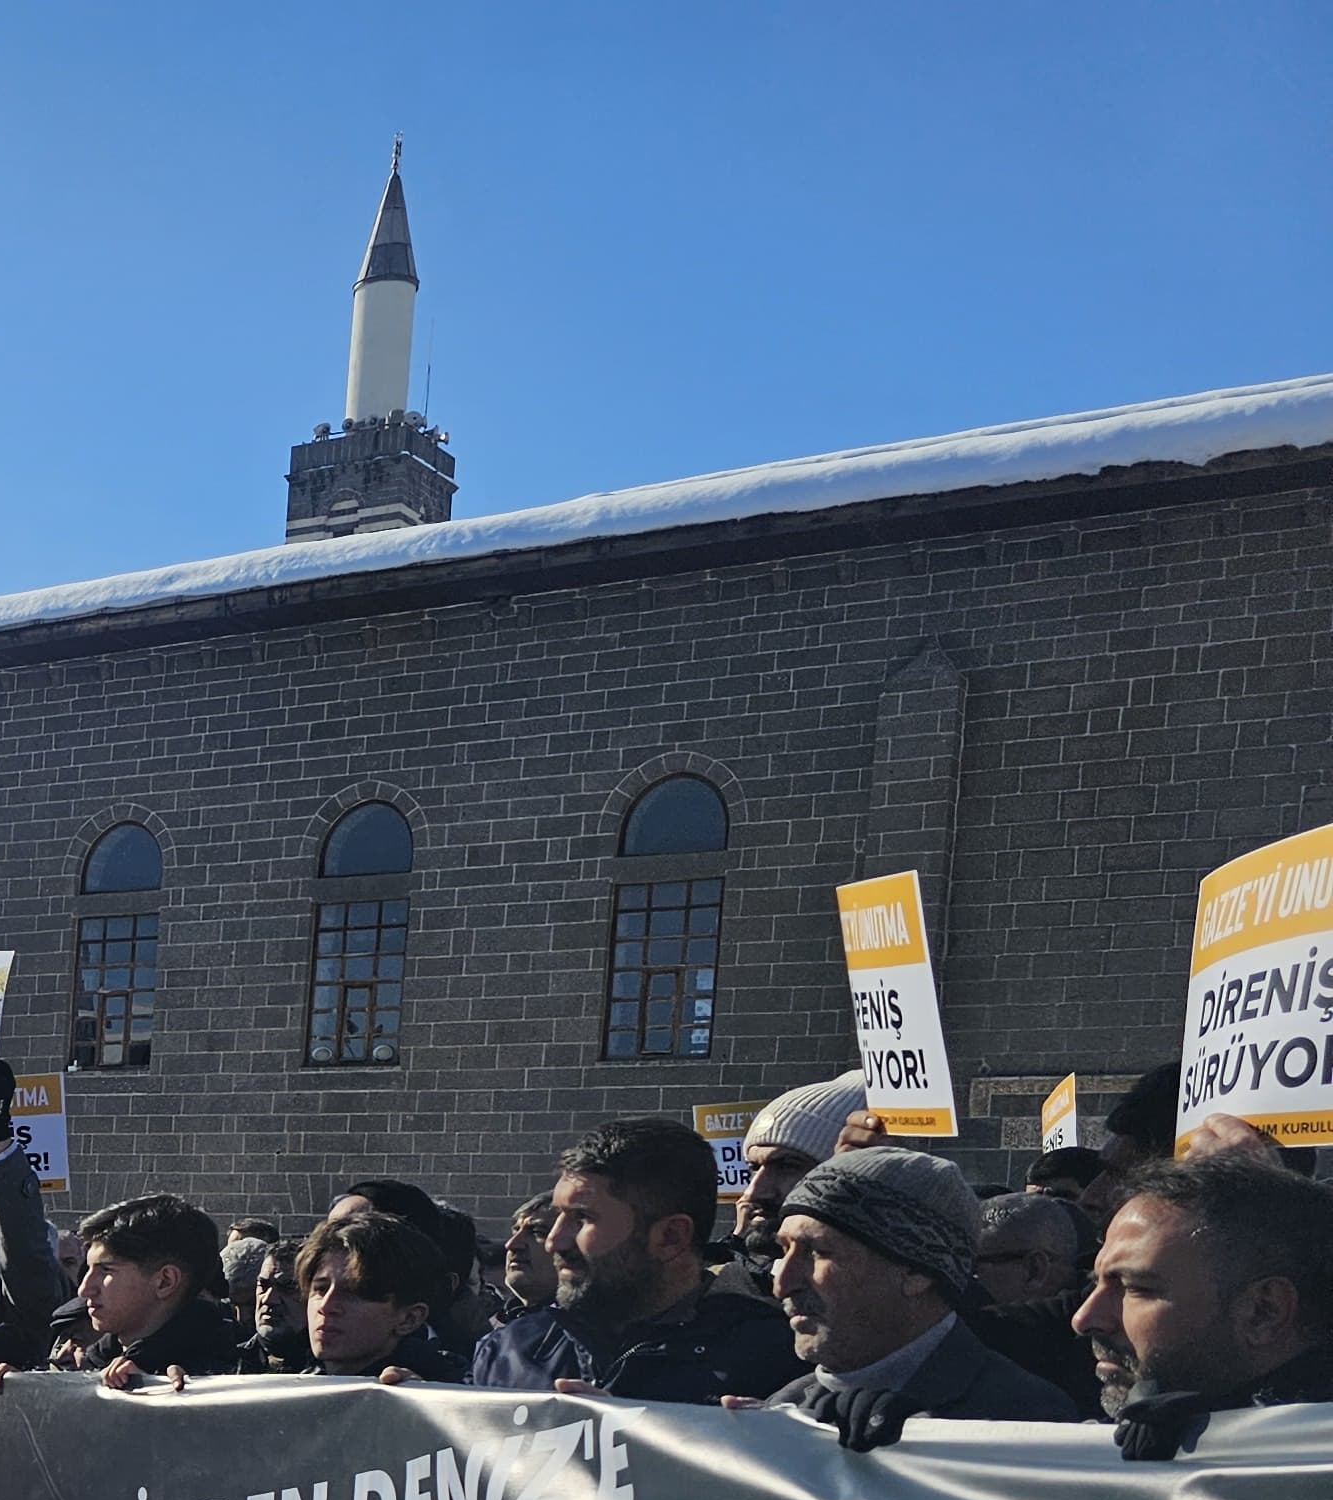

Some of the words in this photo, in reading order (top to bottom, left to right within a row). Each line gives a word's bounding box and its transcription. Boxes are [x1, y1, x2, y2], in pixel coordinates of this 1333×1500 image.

[1199, 862, 1281, 951] GAZZE'Yİ
[1278, 857, 1333, 919] UNU
[853, 978, 904, 1041] RENİŞ
[862, 1040, 929, 1090] ÜYOR!
[1182, 1034, 1333, 1113] SÜRÜYO
